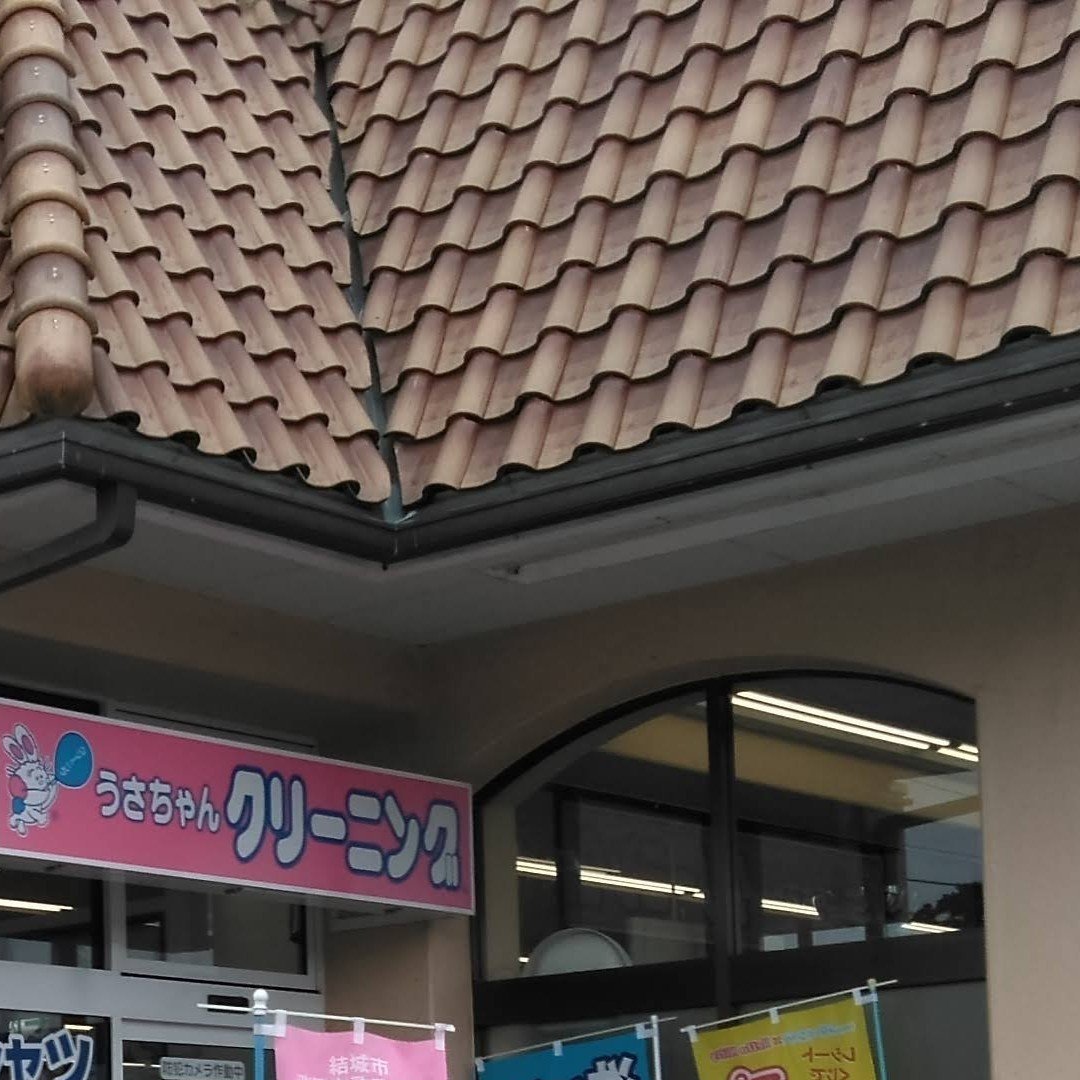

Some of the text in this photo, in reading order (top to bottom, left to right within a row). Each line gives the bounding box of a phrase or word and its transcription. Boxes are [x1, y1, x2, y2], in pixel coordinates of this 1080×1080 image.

[94, 765, 461, 891] うさちゃん クリーニング
[329, 1054, 390, 1076] 結城市
